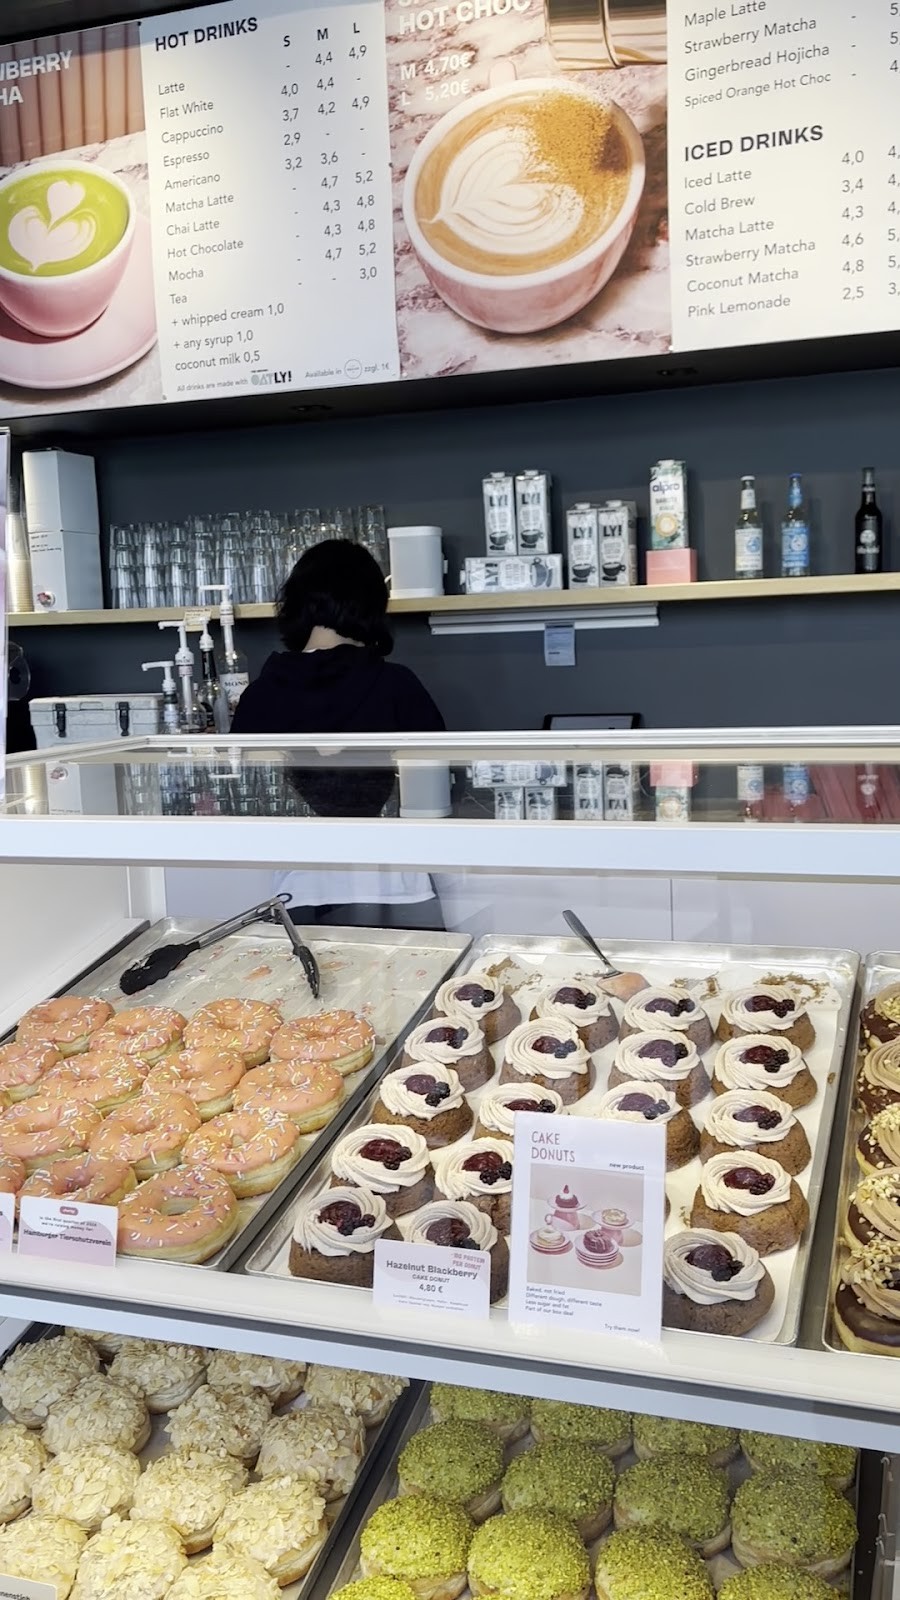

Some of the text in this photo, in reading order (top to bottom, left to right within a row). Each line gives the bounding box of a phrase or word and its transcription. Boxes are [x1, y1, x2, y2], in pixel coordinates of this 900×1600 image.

[400, 6, 448, 34] HOT
[684, 1, 766, 27] Maple Latte
[155, 17, 258, 51] HOT DRINKS
[283, 22, 360, 47] S M L
[685, 30, 760, 54] Strawberry
[764, 18, 817, 37] Matcha
[158, 45, 366, 95] Latte 4,4 4,9
[400, 52, 472, 80] M 4,70€
[685, 52, 771, 81] Gingerbread
[777, 44, 830, 64] Hojicha
[160, 77, 334, 120] Flat White 4,0 4,4
[401, 80, 471, 106] L 5,20€
[685, 90, 722, 109] Spiced
[726, 82, 770, 98] Orange
[774, 79, 796, 90] Hot
[800, 72, 831, 86] Choc
[161, 96, 370, 144] Cappuccino 3,7 4,2 4,9
[163, 133, 301, 168] Espresso 2,9
[685, 125, 823, 161] ICED DRINKS
[164, 152, 338, 190] Americano 3,2 3,6
[684, 173, 712, 189] Iced
[717, 169, 752, 184] Latte
[842, 151, 864, 165] 4,0
[165, 170, 373, 214] Matcha Latte 4,7 5,2
[684, 199, 716, 215] Cold
[721, 196, 755, 210] Brew
[842, 179, 864, 194] 3,4
[166, 194, 375, 237] Chai Latte 4,3 4,8
[686, 224, 734, 241] Matcha
[740, 220, 774, 234] Latte
[842, 206, 864, 220] 4,3
[167, 219, 375, 259] Hot Chocolate 4,3 4,8
[686, 246, 760, 267] Strawberry
[764, 239, 815, 256] Matcha
[842, 233, 864, 248] 4,6
[169, 242, 376, 281] Mocha 4,7 5,2
[687, 276, 743, 292] Coconut
[748, 268, 799, 285] Matcha
[842, 260, 864, 274] 4,8
[170, 266, 377, 305] Tea 3,0
[688, 304, 715, 318] Pink
[720, 295, 791, 314] Lemonade
[843, 287, 864, 301] 2,5
[182, 303, 284, 328] whipped cream 1,0
[184, 330, 253, 350] any syrup 1,0
[175, 350, 260, 371] coconut milk 0,5
[305, 368, 334, 378] Available
[652, 482, 680, 494] alpro
[603, 525, 622, 538] LY!
[531, 1131, 560, 1145] CAKE
[531, 1147, 575, 1162] DONUTS
[24, 1229, 111, 1246] Hamburger Tierschutzverein
[386, 1260, 477, 1280] Hazelnut Blackberry
[419, 1284, 436, 1292] 4,80
